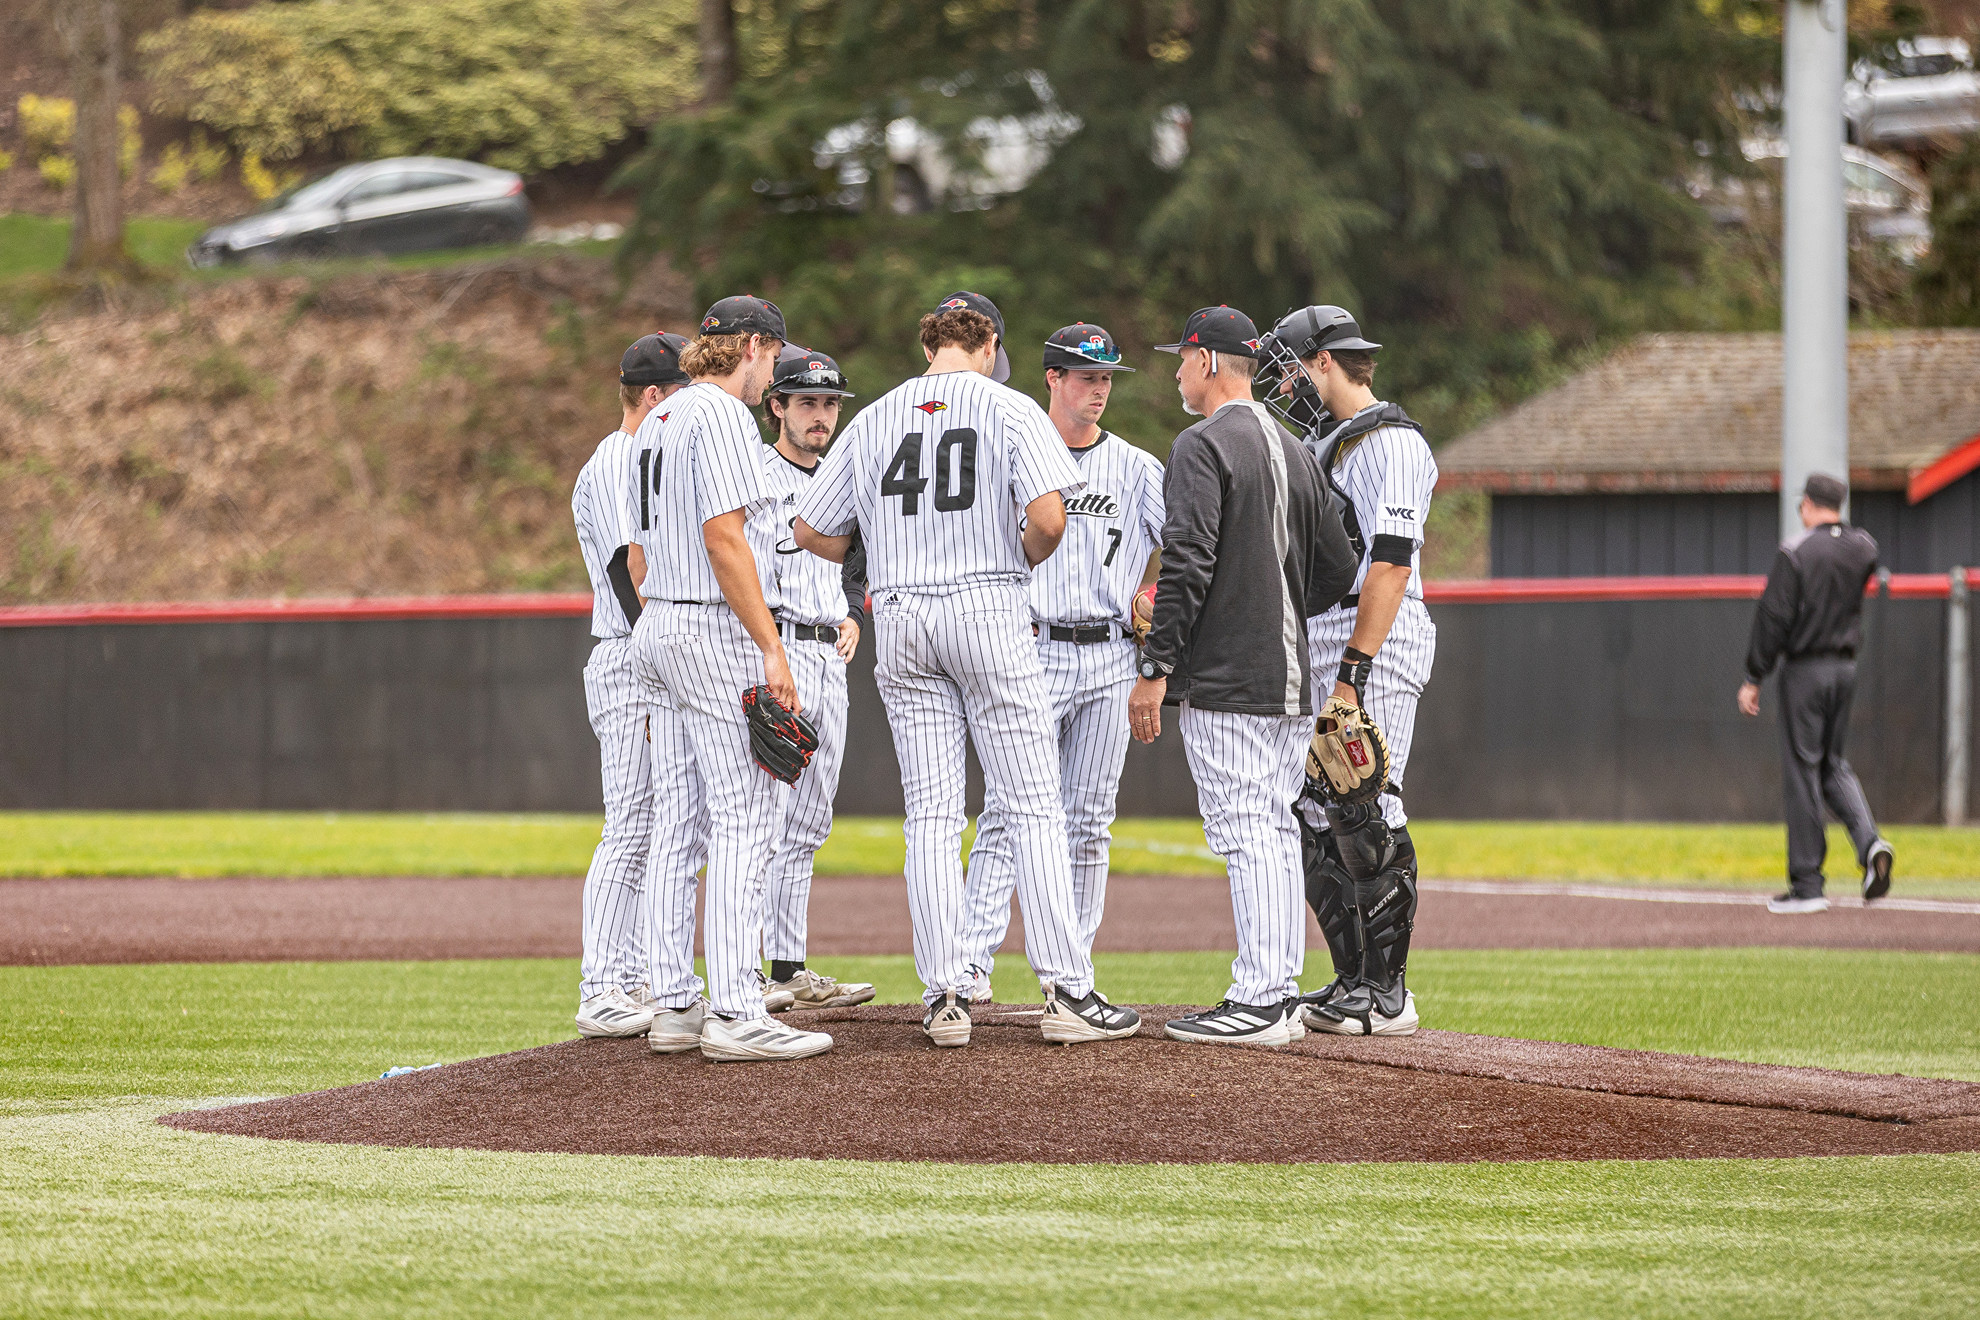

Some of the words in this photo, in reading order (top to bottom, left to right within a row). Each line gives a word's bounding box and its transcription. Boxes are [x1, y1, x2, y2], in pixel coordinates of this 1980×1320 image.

[881, 427, 977, 516] 40
[1385, 506, 1415, 521] WCC
[1103, 527, 1122, 567] 7
[1367, 886, 1399, 918] EASTON
